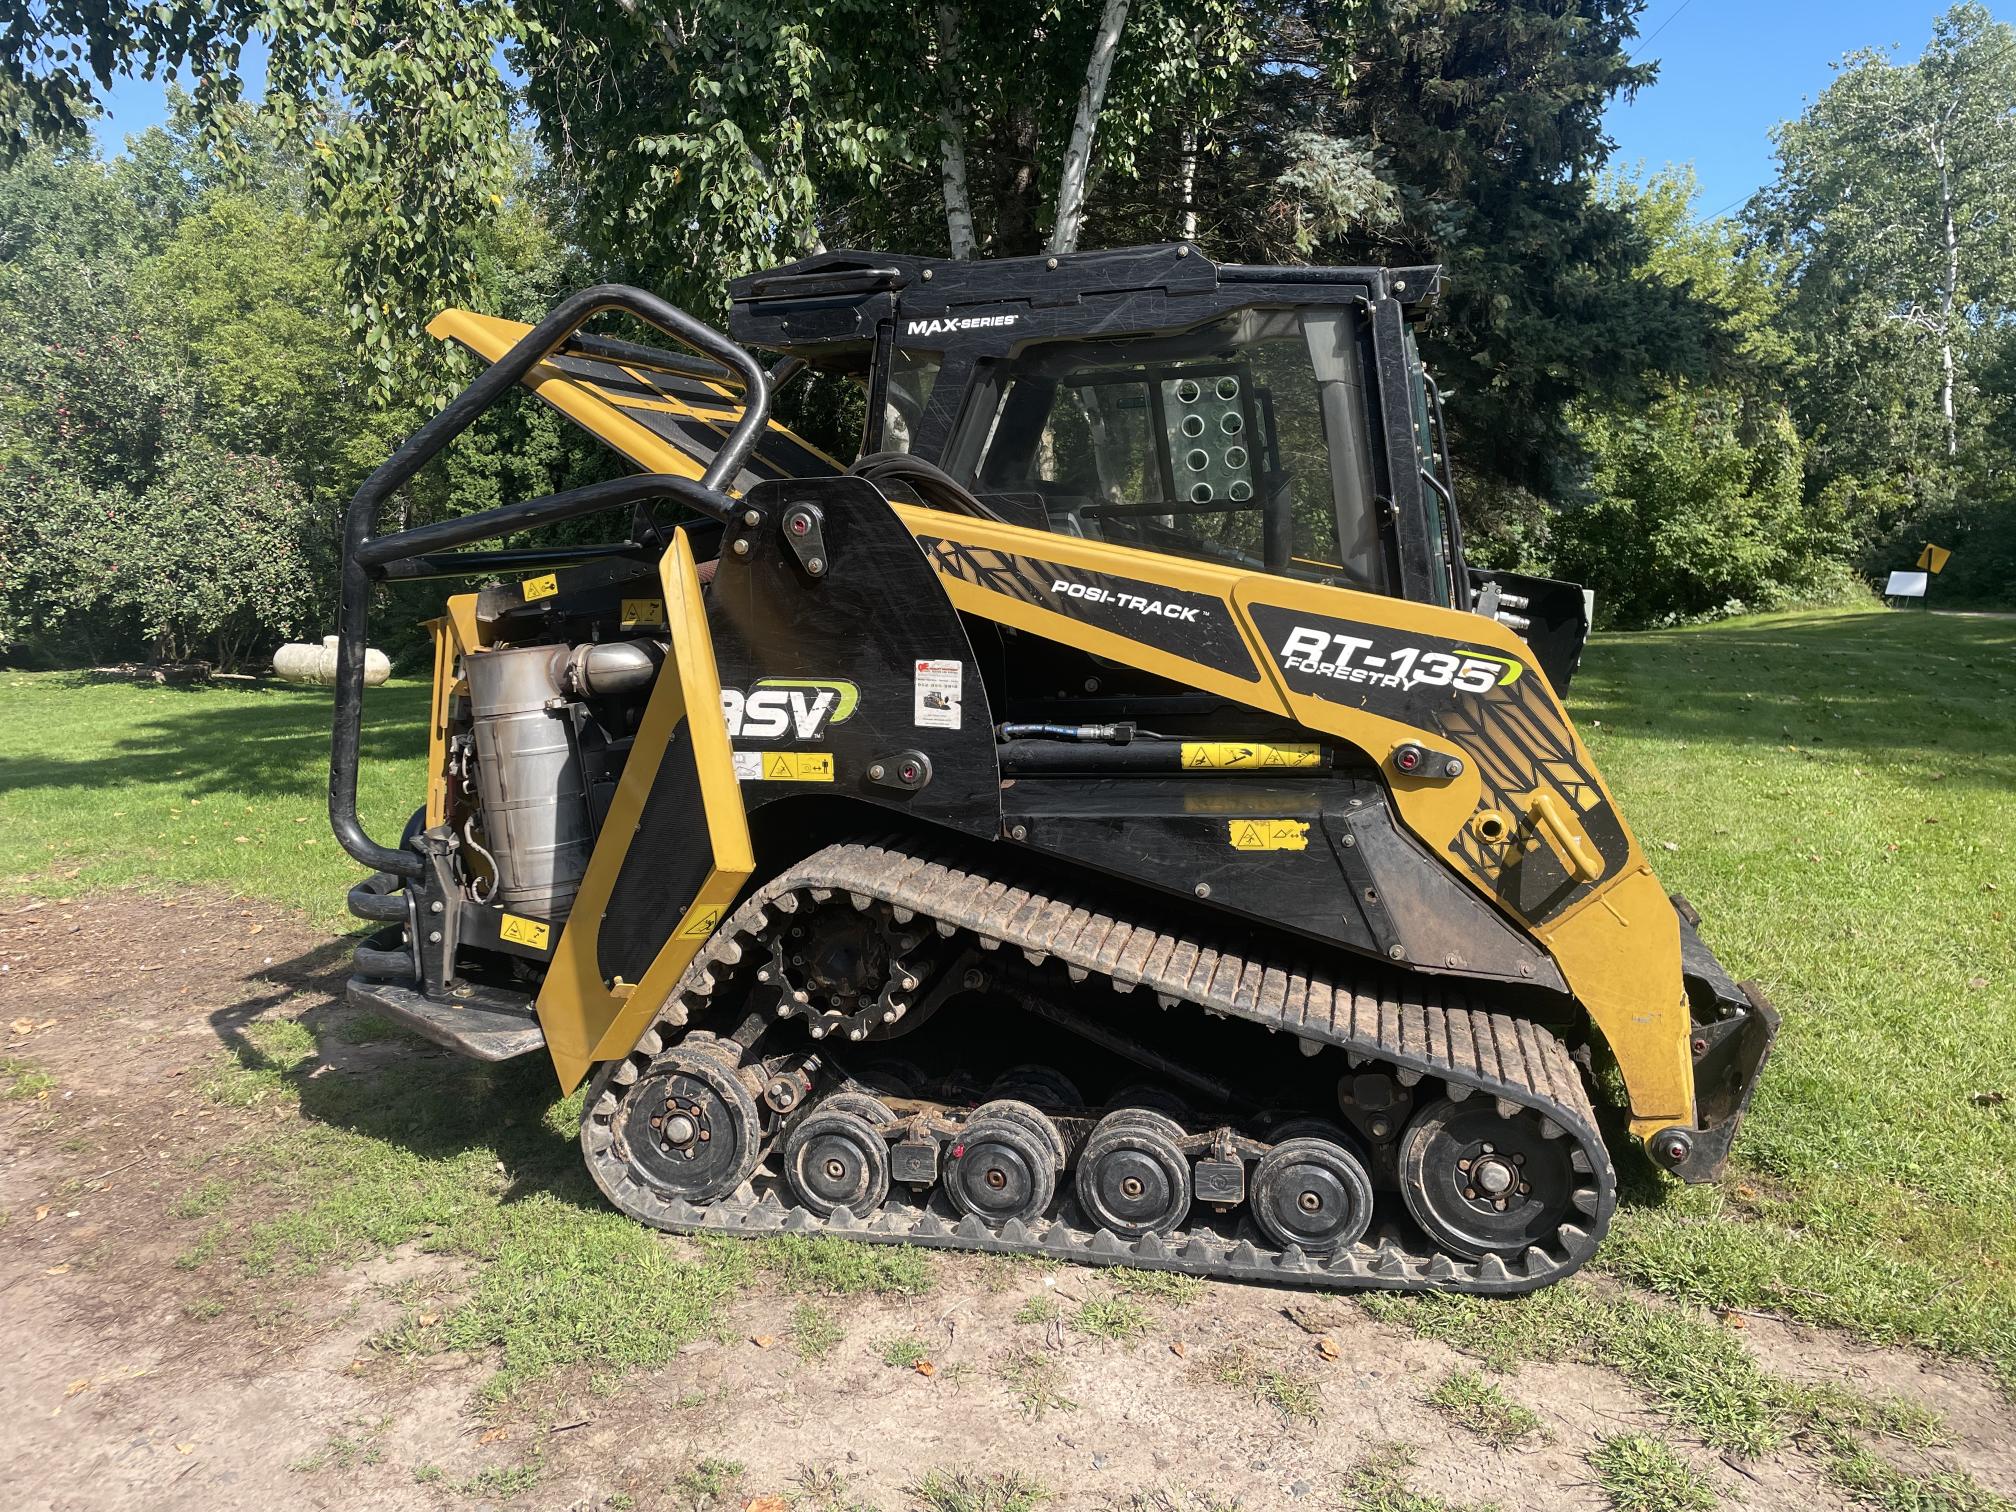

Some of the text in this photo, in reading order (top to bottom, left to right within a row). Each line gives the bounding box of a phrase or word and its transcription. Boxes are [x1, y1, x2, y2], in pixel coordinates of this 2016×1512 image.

[1051, 580, 1200, 622] POSI-TRACK
[1280, 626, 1502, 693] RT-135
[1284, 657, 1420, 691] FORESTRY
